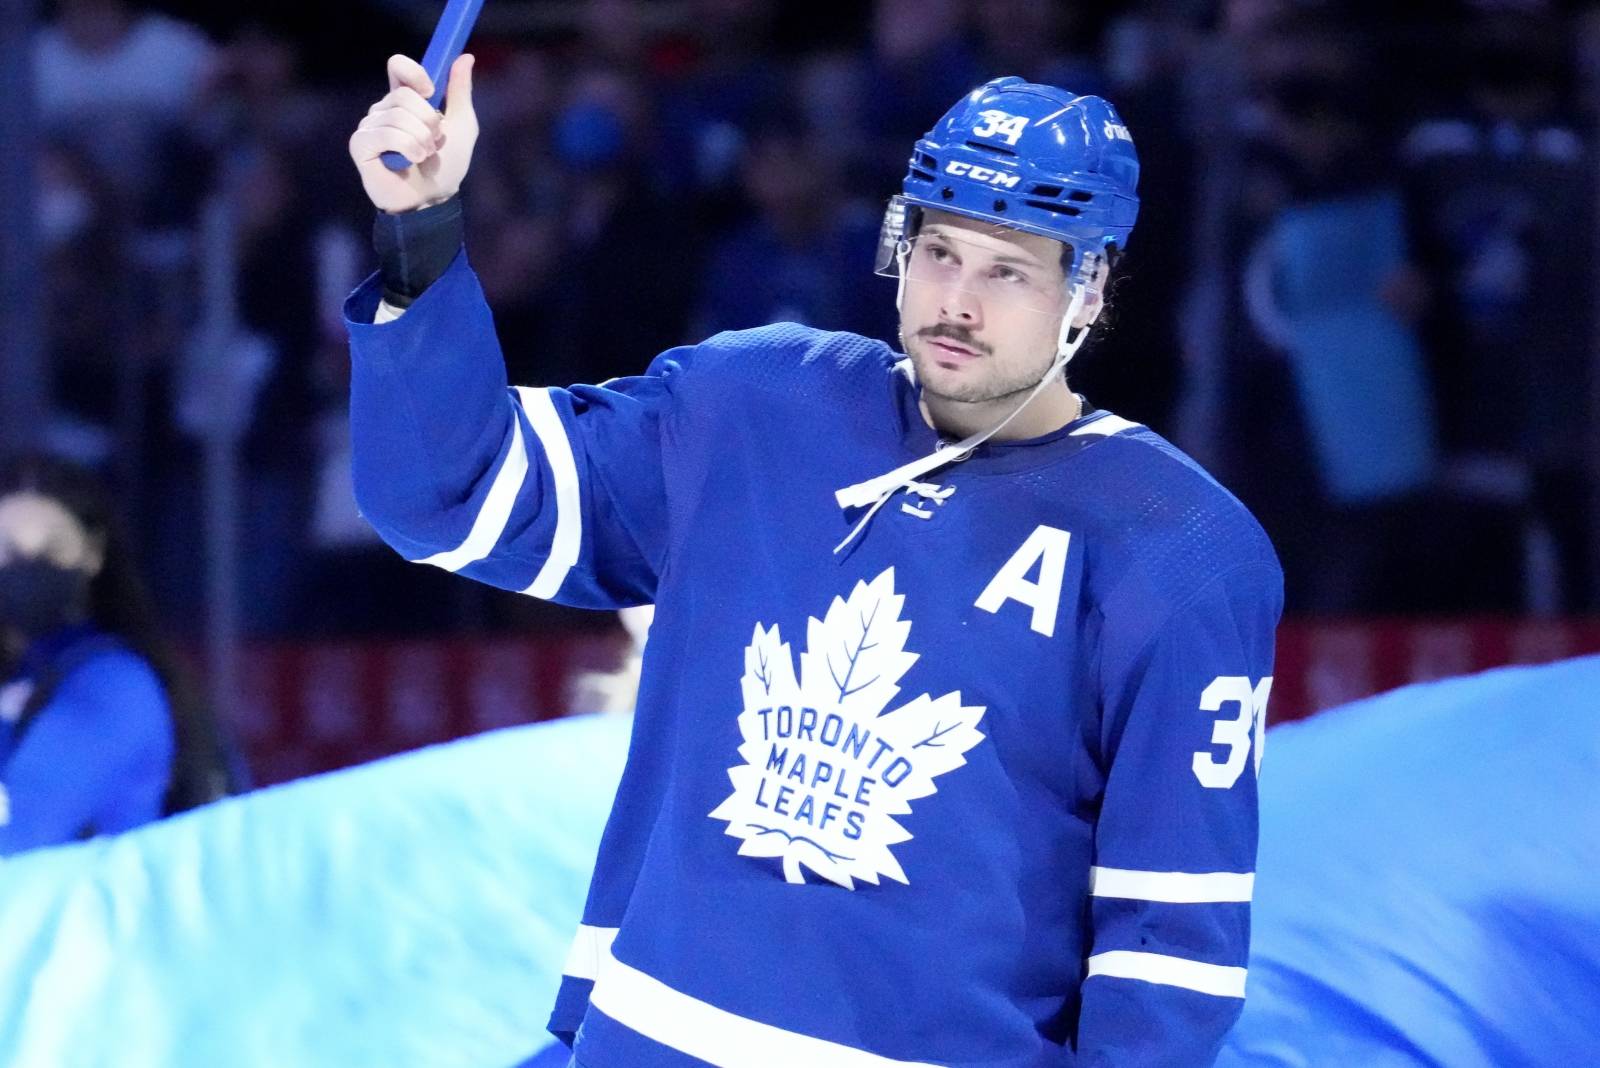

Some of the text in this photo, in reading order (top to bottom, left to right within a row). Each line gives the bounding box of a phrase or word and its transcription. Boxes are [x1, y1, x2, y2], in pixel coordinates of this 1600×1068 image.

[973, 109, 1030, 146] 34
[945, 160, 1021, 188] CCM
[973, 524, 1072, 638] A
[757, 705, 913, 788] TORONTO
[765, 742, 877, 806] MAPLE
[755, 777, 866, 841] LEAFS
